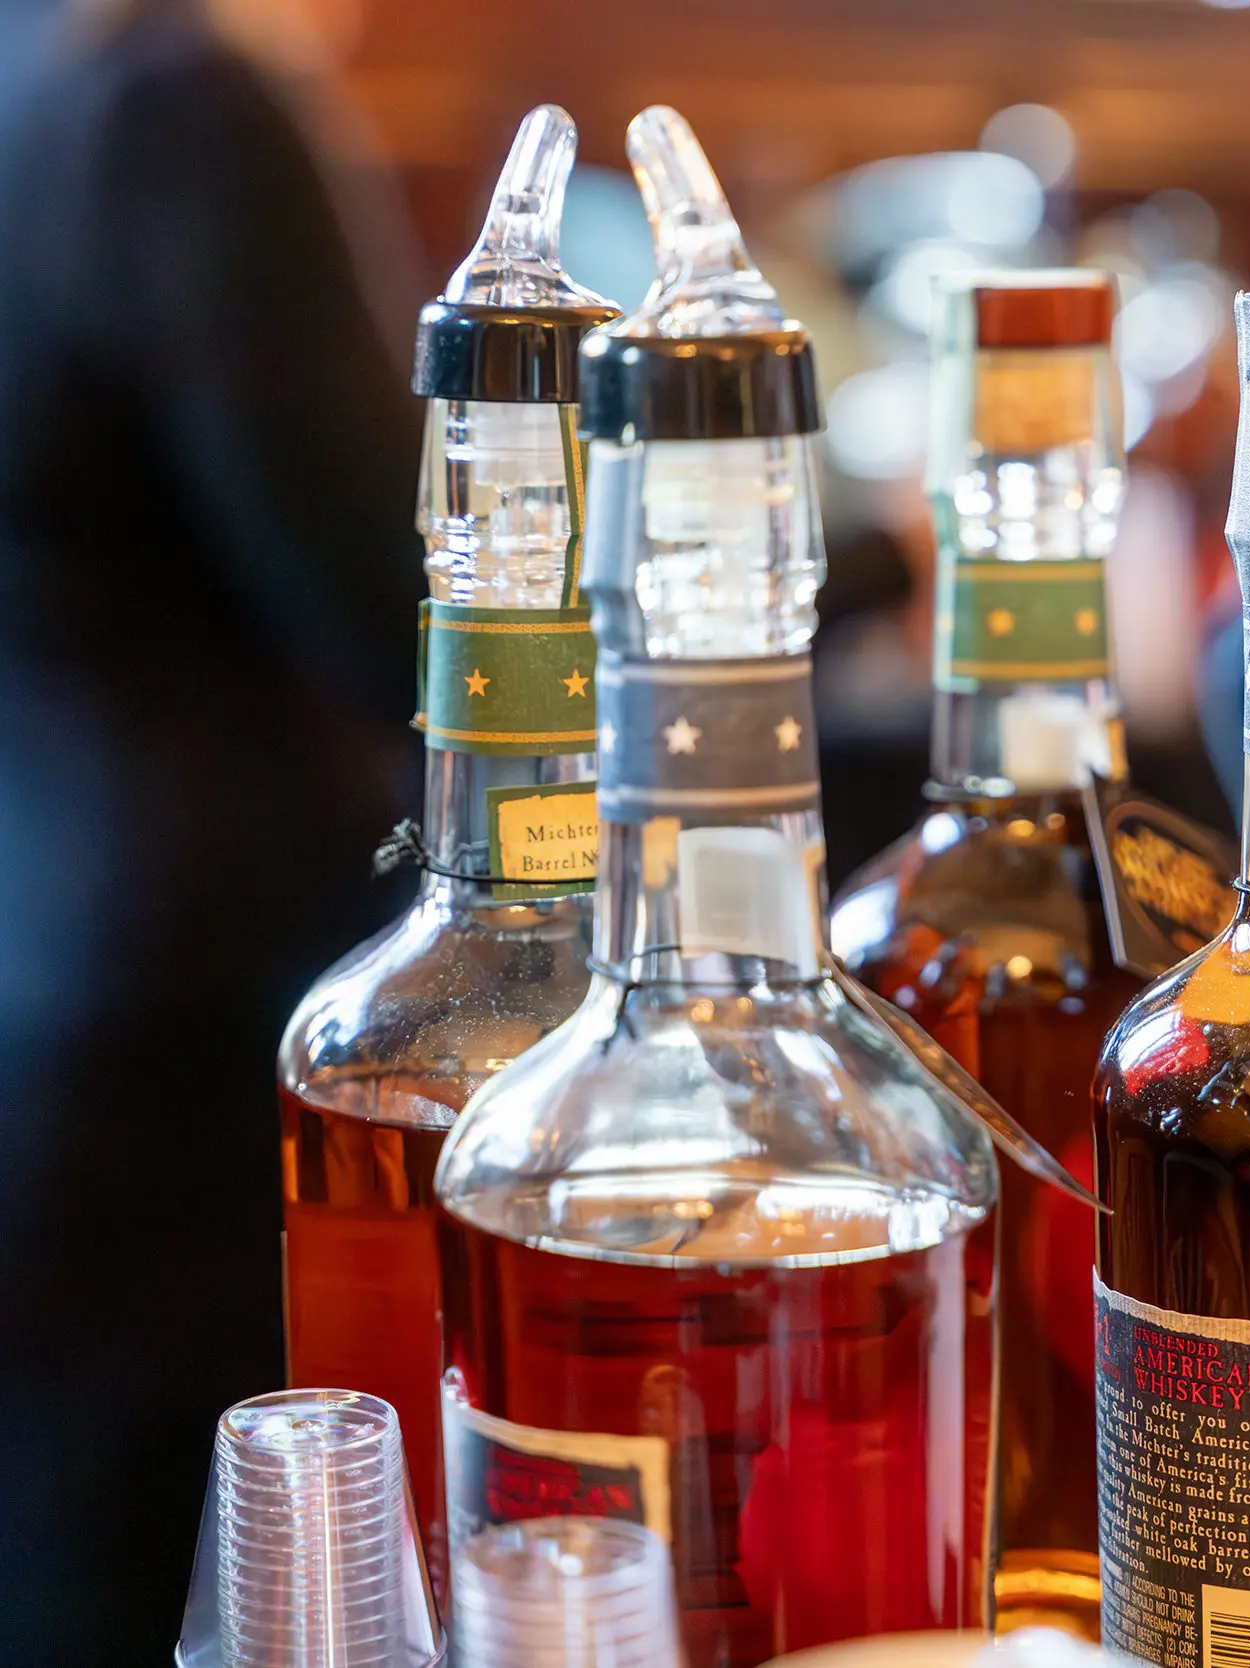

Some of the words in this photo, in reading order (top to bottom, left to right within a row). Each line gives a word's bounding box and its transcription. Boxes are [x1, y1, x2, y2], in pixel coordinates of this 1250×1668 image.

[523, 852, 576, 872] Barrel
[1134, 1326, 1219, 1358] UNBLENDED
[1134, 1366, 1246, 1411] WHISKEY
[1112, 1401, 1137, 1427] Small
[1145, 1415, 1180, 1440] Batch
[1132, 1396, 1143, 1410] to
[1152, 1401, 1186, 1422] offer
[1198, 1415, 1226, 1431] you
[1115, 1423, 1129, 1441] the
[1132, 1429, 1190, 1462] Michter's
[1120, 1446, 1136, 1462] one
[1140, 1453, 1152, 1469] of
[1157, 1456, 1226, 1486] America's
[1124, 1464, 1166, 1494] whiskey
[1170, 1478, 1181, 1494] is
[1186, 1485, 1224, 1501] made
[1128, 1481, 1182, 1514] American
[1188, 1505, 1235, 1523] grains
[1126, 1504, 1149, 1522] peak
[1152, 1511, 1166, 1527] of
[1170, 1519, 1247, 1543] perfection
[1135, 1523, 1167, 1544] white
[1173, 1536, 1198, 1552] oak
[1145, 1544, 1207, 1571] mellowed
[1215, 1557, 1233, 1579] by
[1131, 1574, 1166, 1600] ACCORDING
[1167, 1587, 1178, 1603] TO
[1179, 1591, 1196, 1608] THE
[1131, 1589, 1154, 1613] SHOULD
[1155, 1601, 1170, 1618] NOT
[1171, 1605, 1196, 1625] DRINK
[1142, 1611, 1182, 1637] PREGNANCY
[1184, 1625, 1199, 1641] BE-
[1164, 1652, 1196, 1668] IMPAIRS
[1166, 1637, 1177, 1655] (2)
[1178, 1640, 1199, 1657] CON-
